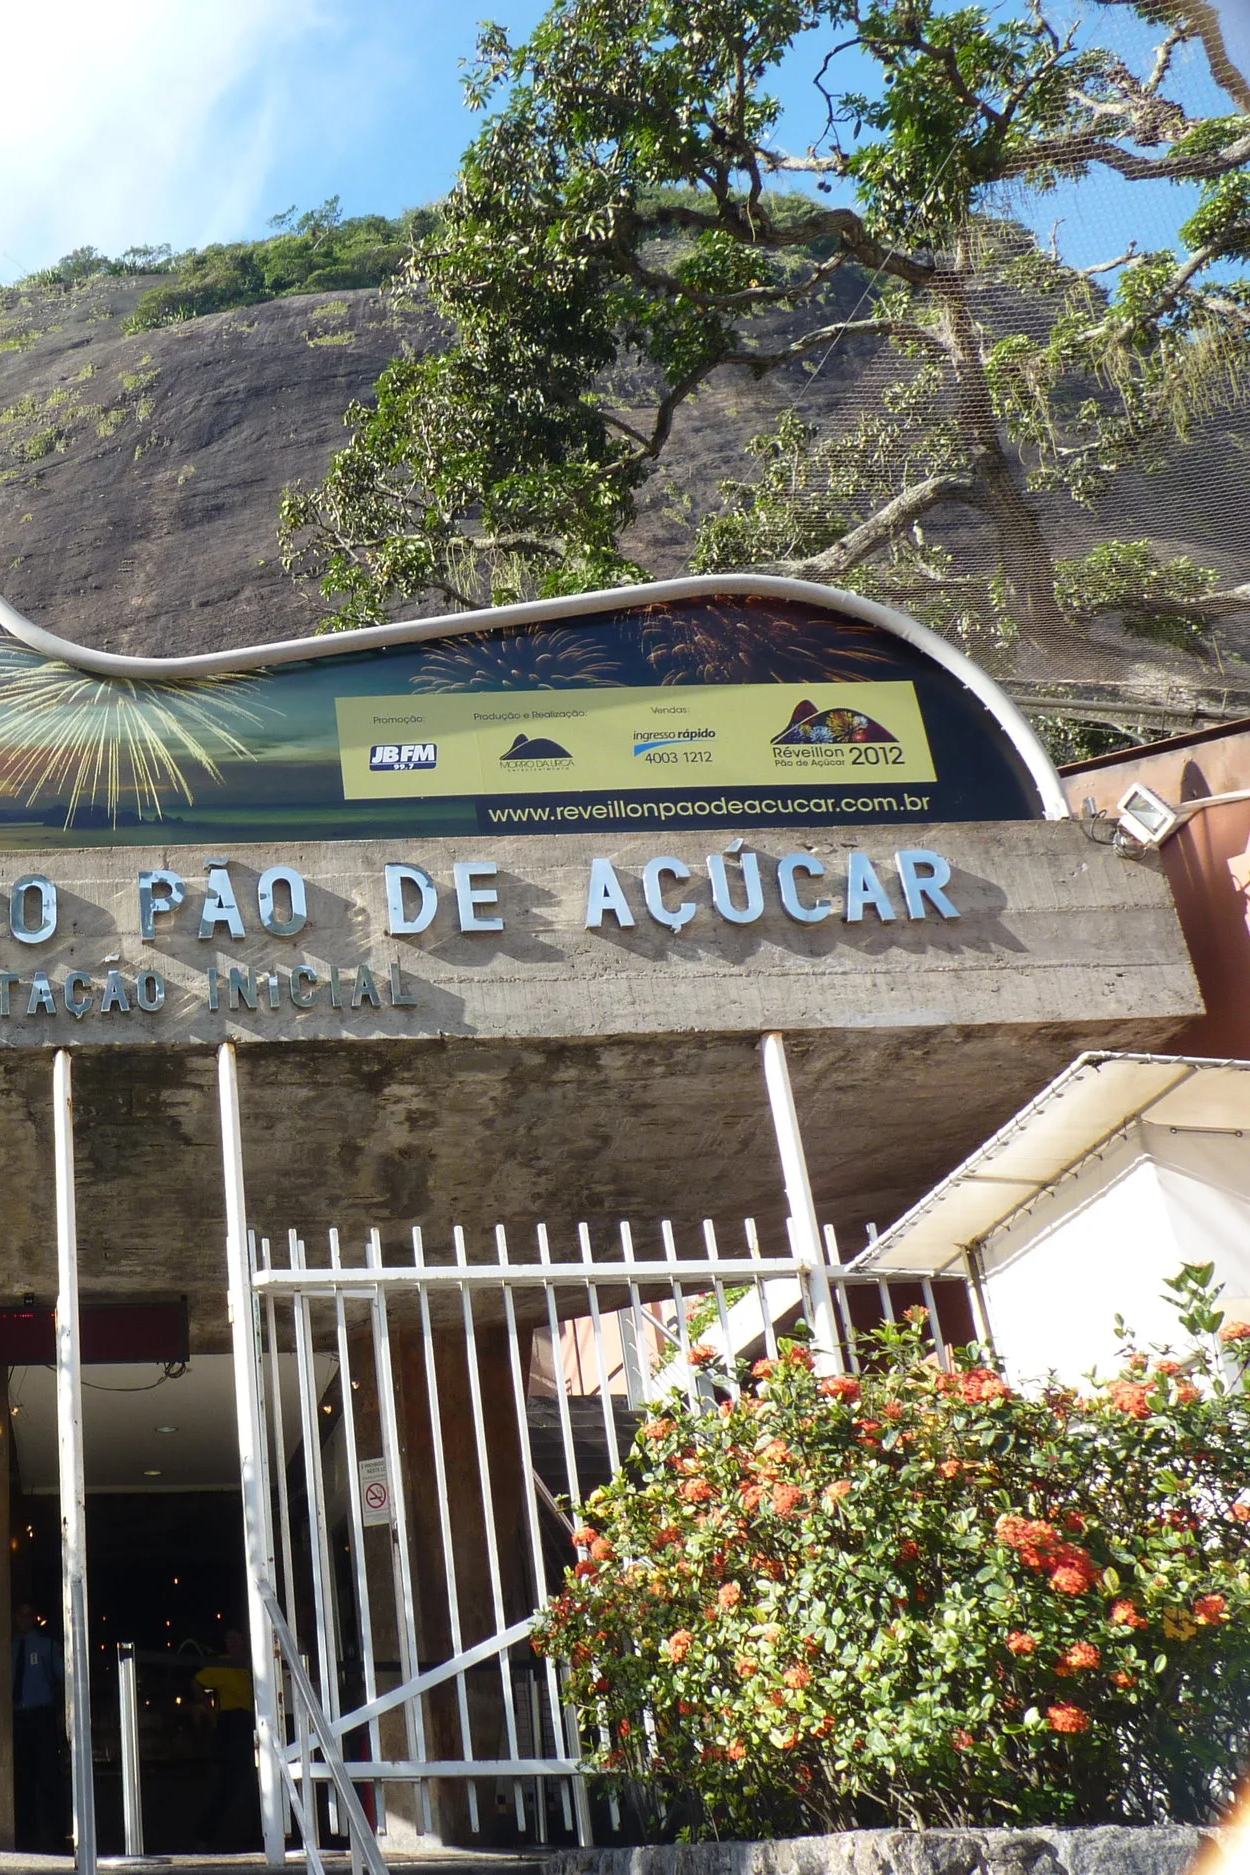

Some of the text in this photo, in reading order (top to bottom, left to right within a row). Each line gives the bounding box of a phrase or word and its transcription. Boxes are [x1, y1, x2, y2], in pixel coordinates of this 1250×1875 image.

[473, 711, 521, 722] Produção
[532, 709, 589, 720] Realização:
[651, 705, 691, 715] Vendas:
[373, 715, 425, 725] Promoção:
[633, 728, 716, 742] ingresso rápido
[644, 751, 713, 764] 4003 1212
[772, 746, 845, 759] Réveillon
[850, 746, 906, 766] 2012
[393, 763, 415, 771] 99.7
[500, 759, 575, 769] MORRO DA URCA
[774, 758, 846, 768] Pão de Açúcar
[487, 793, 931, 824] www.reveillonpaodeacucar.com.br
[137, 856, 307, 942] PÃO
[384, 860, 505, 936] DE
[584, 838, 962, 934] AÇÚCAR
[207, 955, 419, 1013] INICIAL
